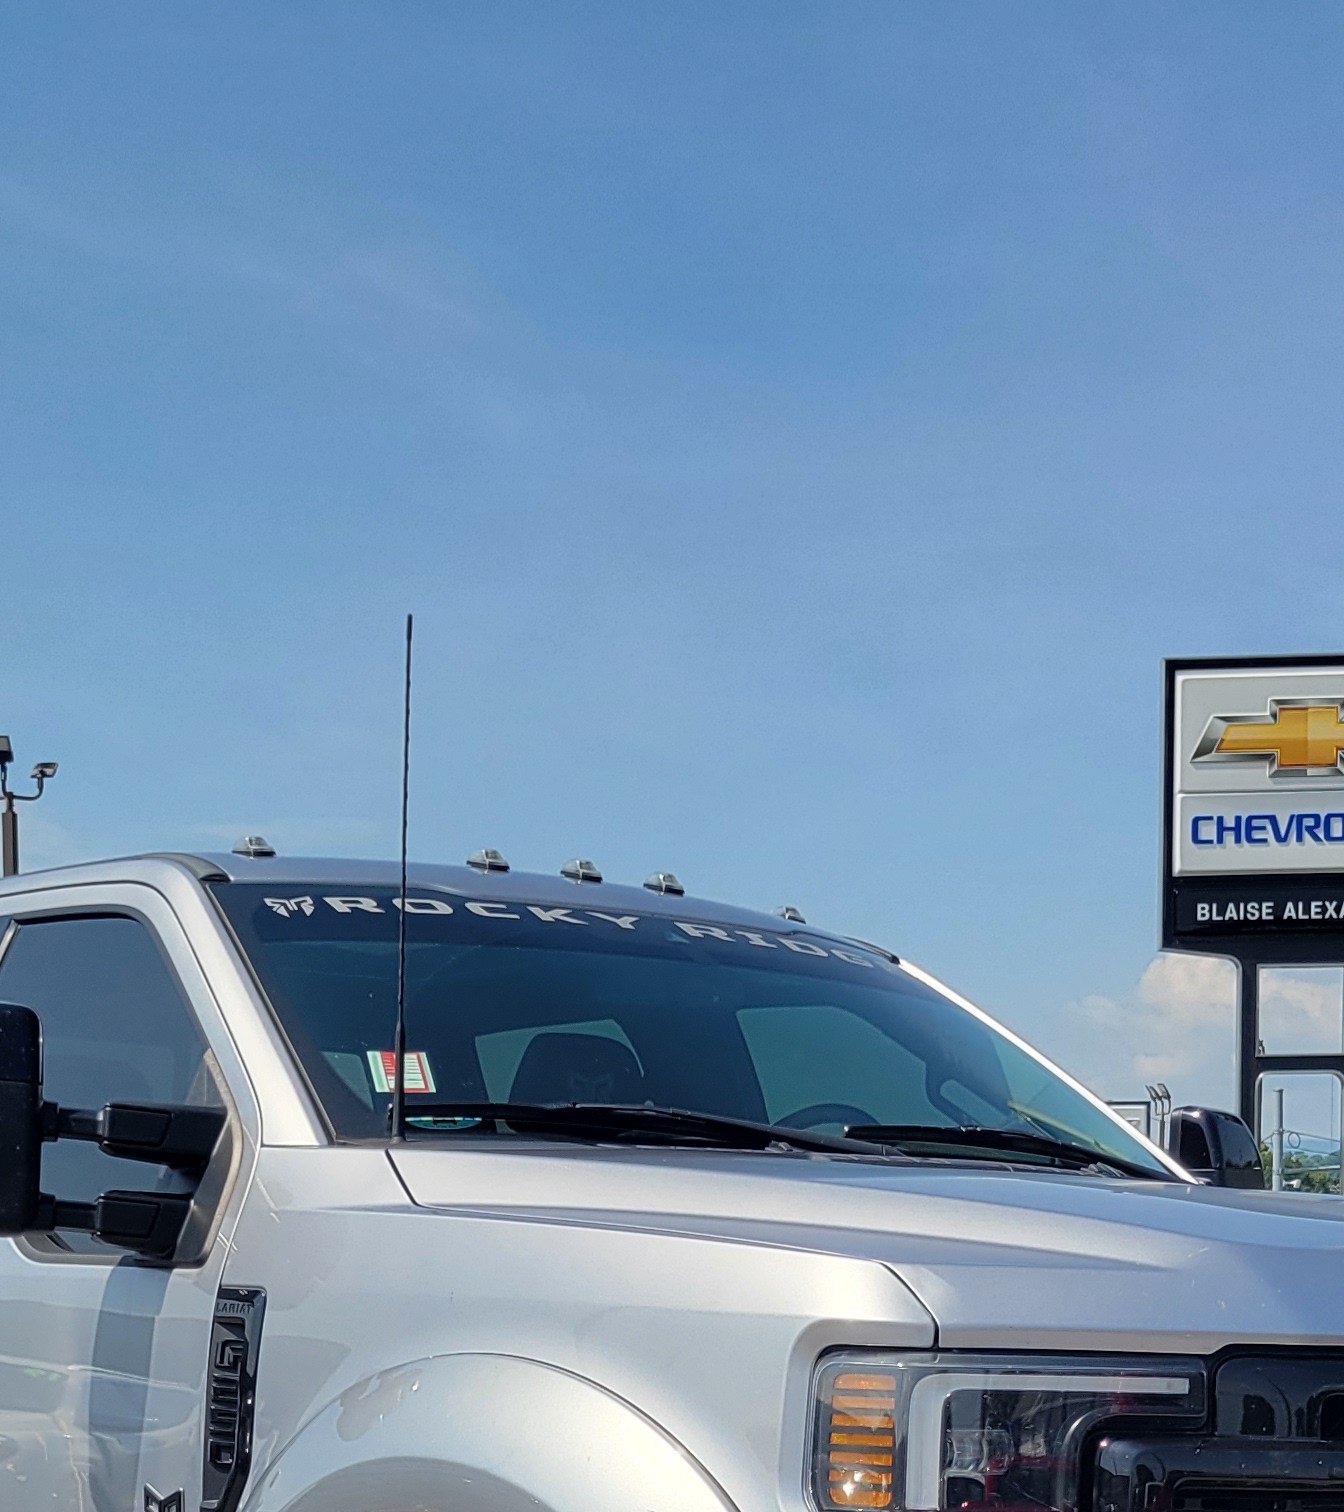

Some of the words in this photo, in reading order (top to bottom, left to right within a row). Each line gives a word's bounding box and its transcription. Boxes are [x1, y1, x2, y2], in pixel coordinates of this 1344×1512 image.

[323, 894, 639, 930] ROCKY
[1197, 901, 1274, 921] BLAISE
[216, 1302, 253, 1315] LARIAT
